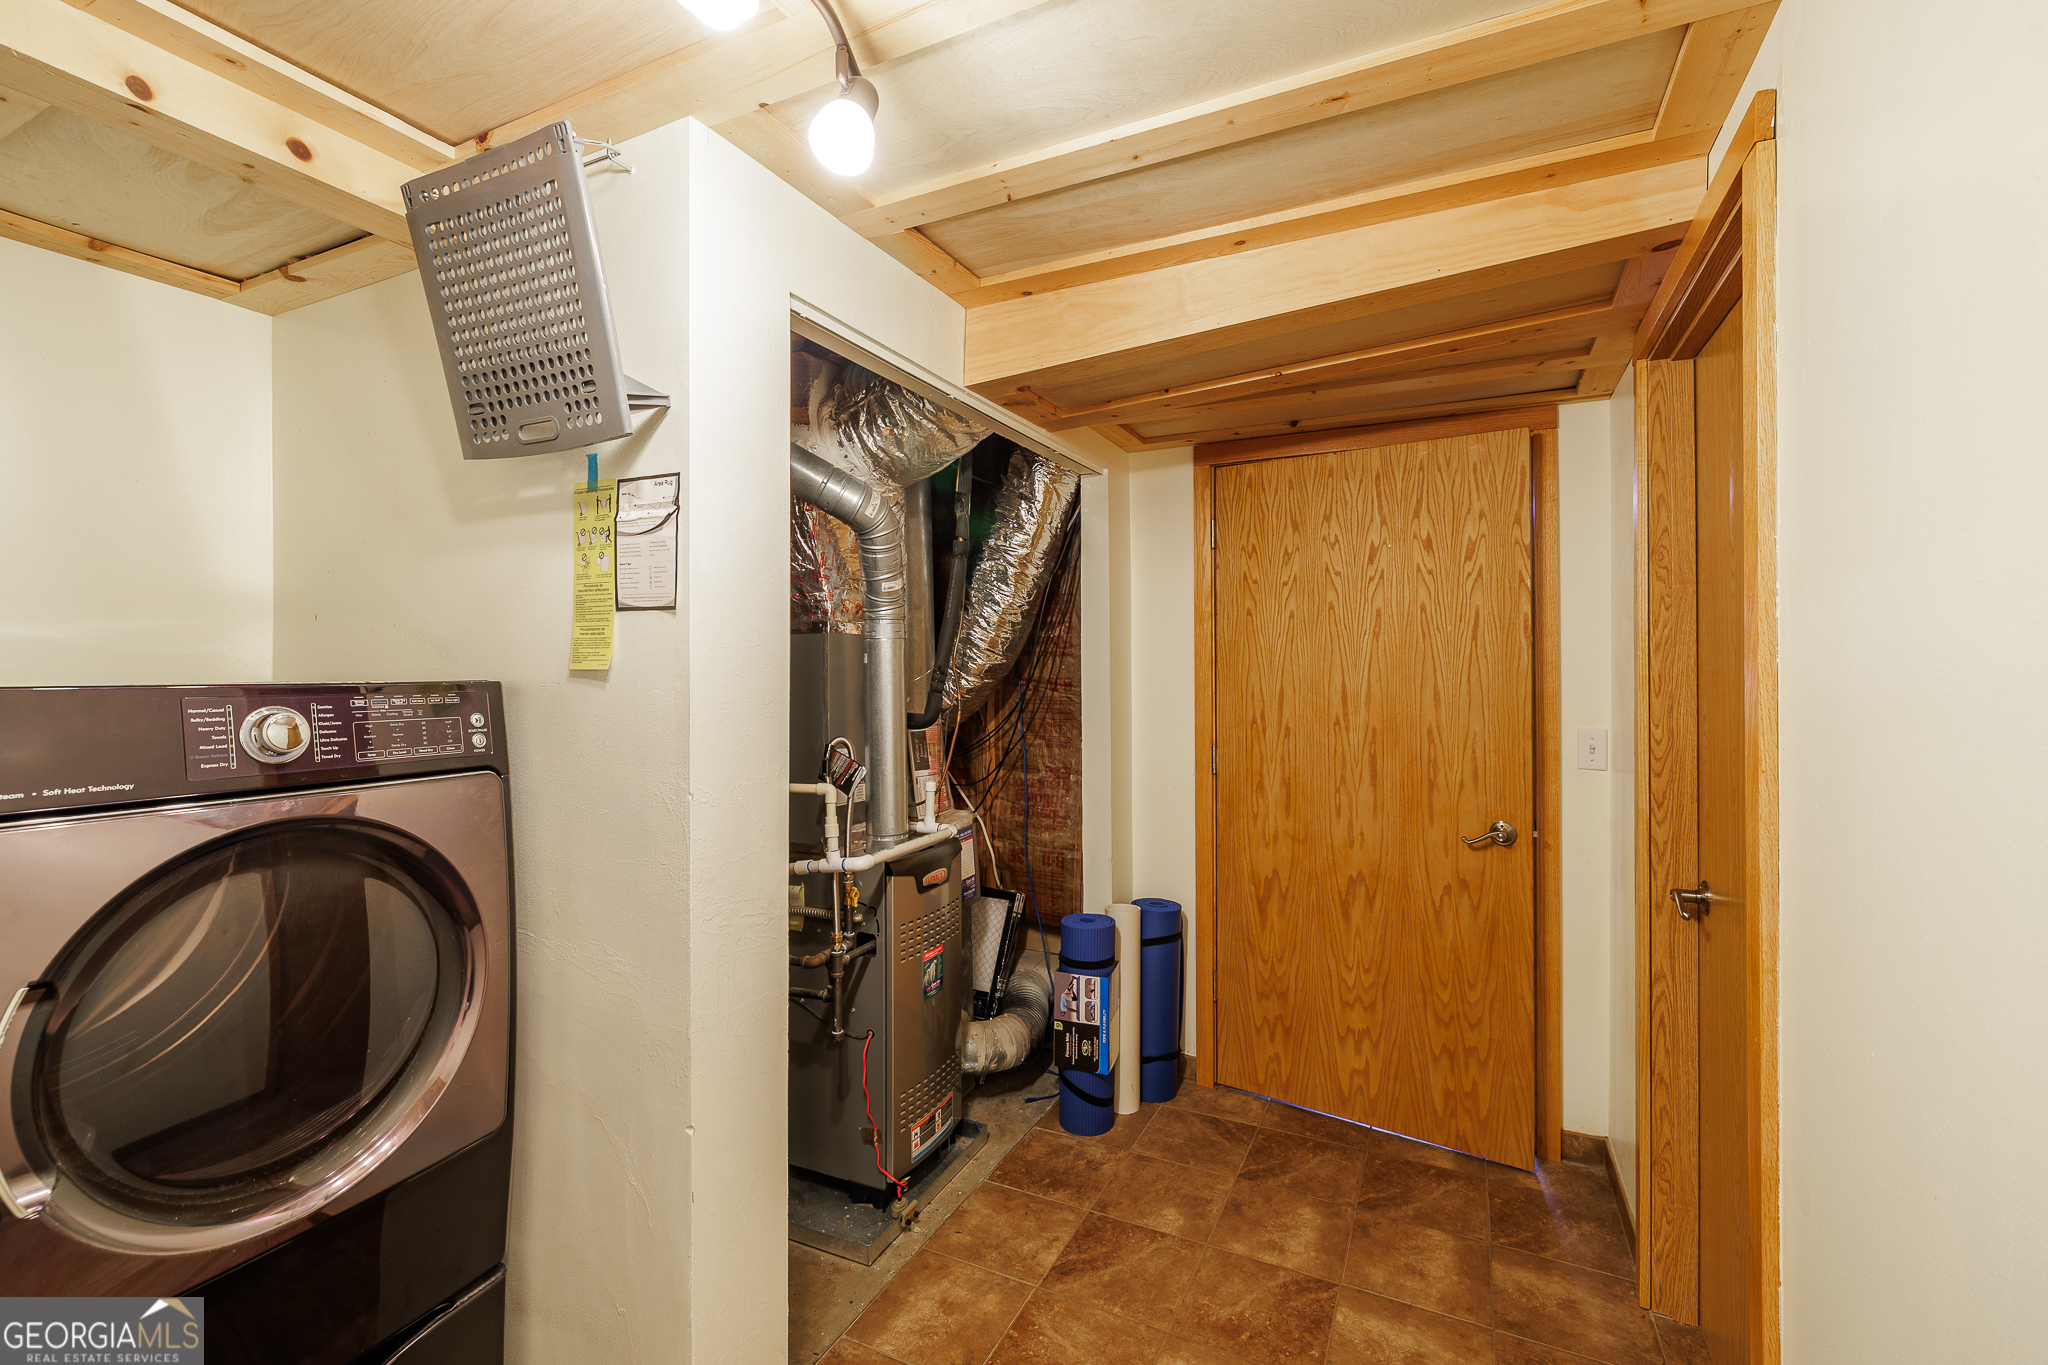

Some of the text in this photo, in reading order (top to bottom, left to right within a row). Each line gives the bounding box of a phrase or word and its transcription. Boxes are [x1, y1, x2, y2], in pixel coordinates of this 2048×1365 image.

[42, 789, 61, 797] Soft
[63, 787, 86, 795] Heat
[88, 783, 135, 793] Technology
